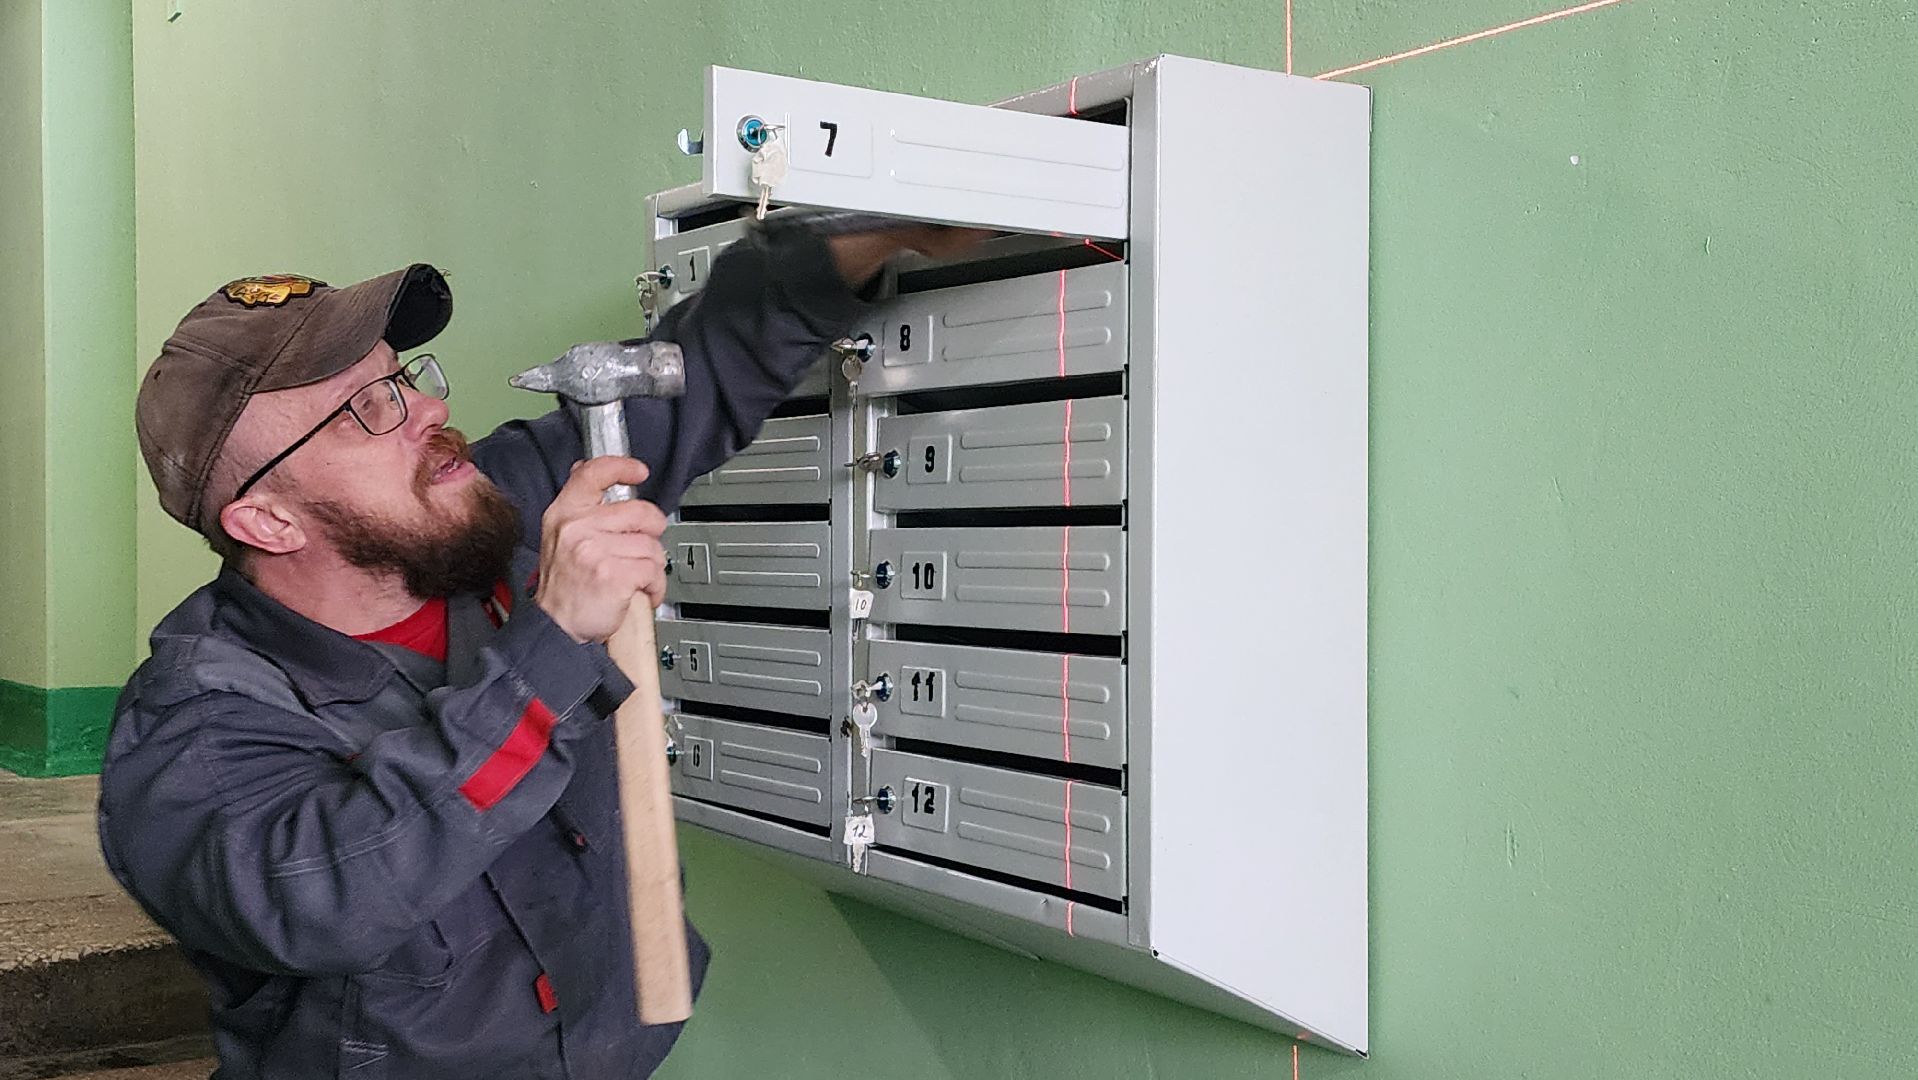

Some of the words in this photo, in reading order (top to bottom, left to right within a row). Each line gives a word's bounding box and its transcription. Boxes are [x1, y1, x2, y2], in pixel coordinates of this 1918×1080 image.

[820, 121, 838, 157] 7
[689, 255, 696, 281] 1
[900, 324, 911, 351] 8
[924, 445, 936, 473] 9
[687, 545, 695, 570] 4
[912, 562, 935, 590] 10
[855, 599, 867, 611] 10
[689, 648, 698, 672] 5
[911, 671, 936, 702] 11
[692, 743, 701, 768] 6
[911, 782, 936, 814] 12
[852, 824, 868, 839] 12
